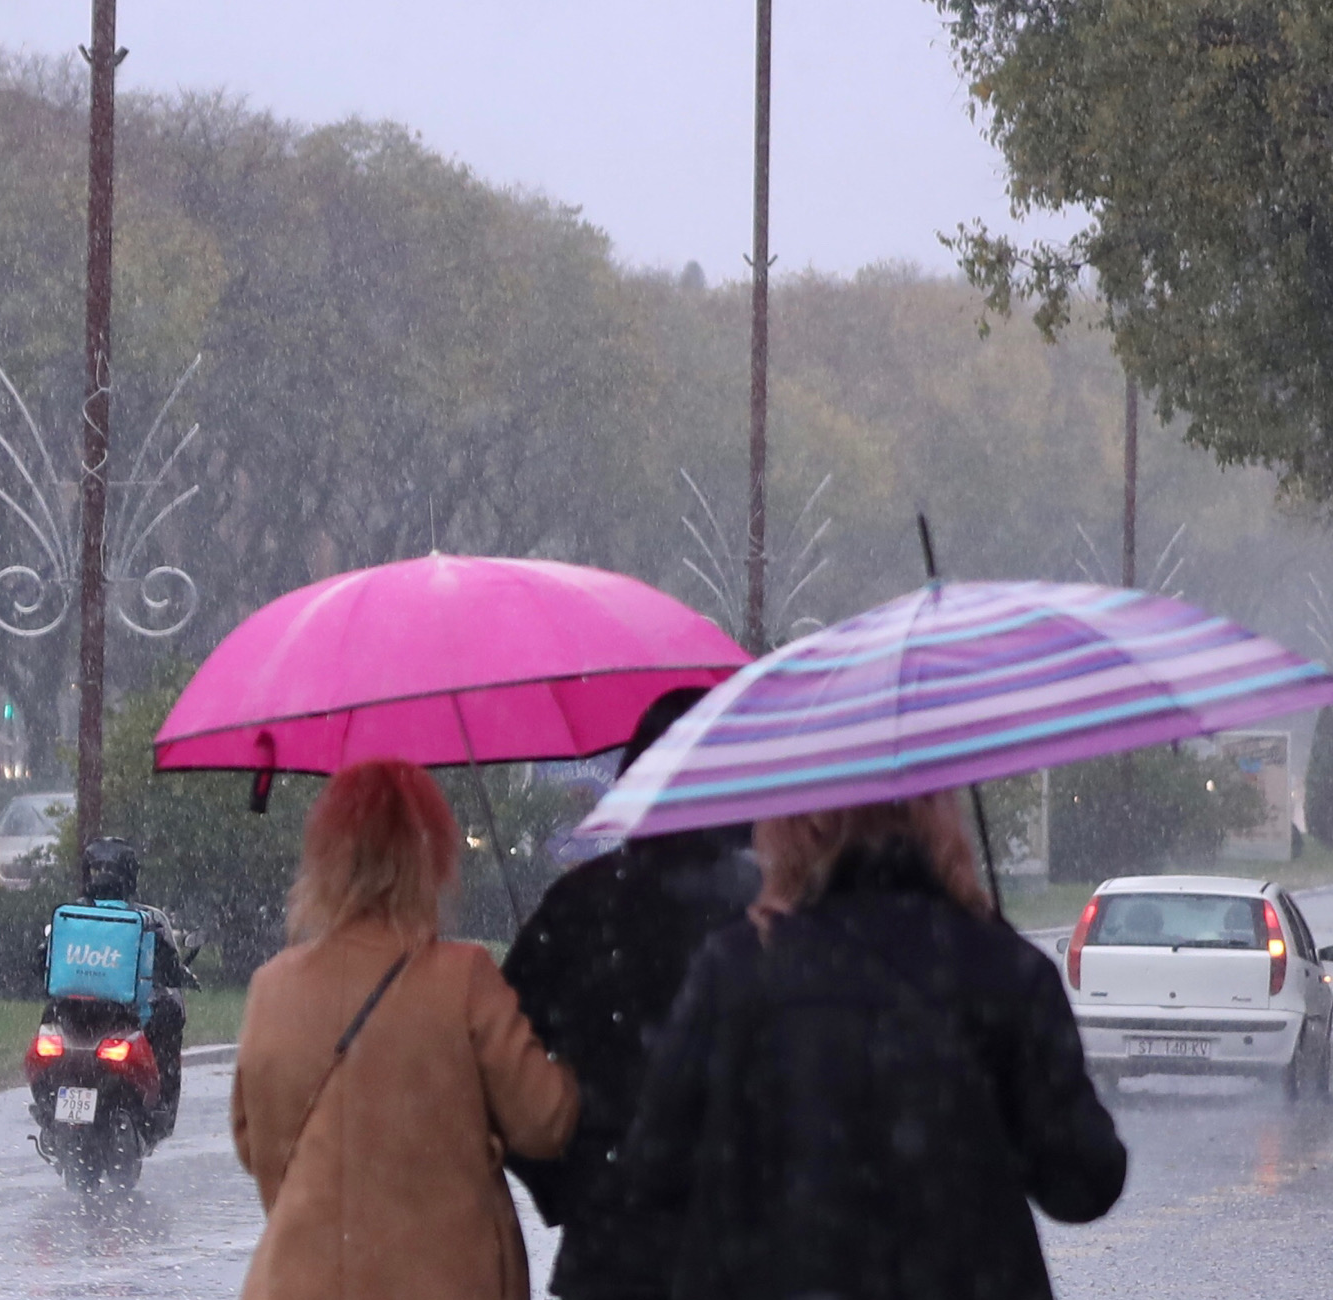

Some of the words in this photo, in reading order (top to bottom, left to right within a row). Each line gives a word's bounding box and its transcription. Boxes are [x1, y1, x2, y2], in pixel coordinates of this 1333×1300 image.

[66, 944, 121, 968] Wolt
[68, 1089, 83, 1100] ST
[62, 1100, 91, 1111] 7095
[68, 1110, 82, 1120] AC
